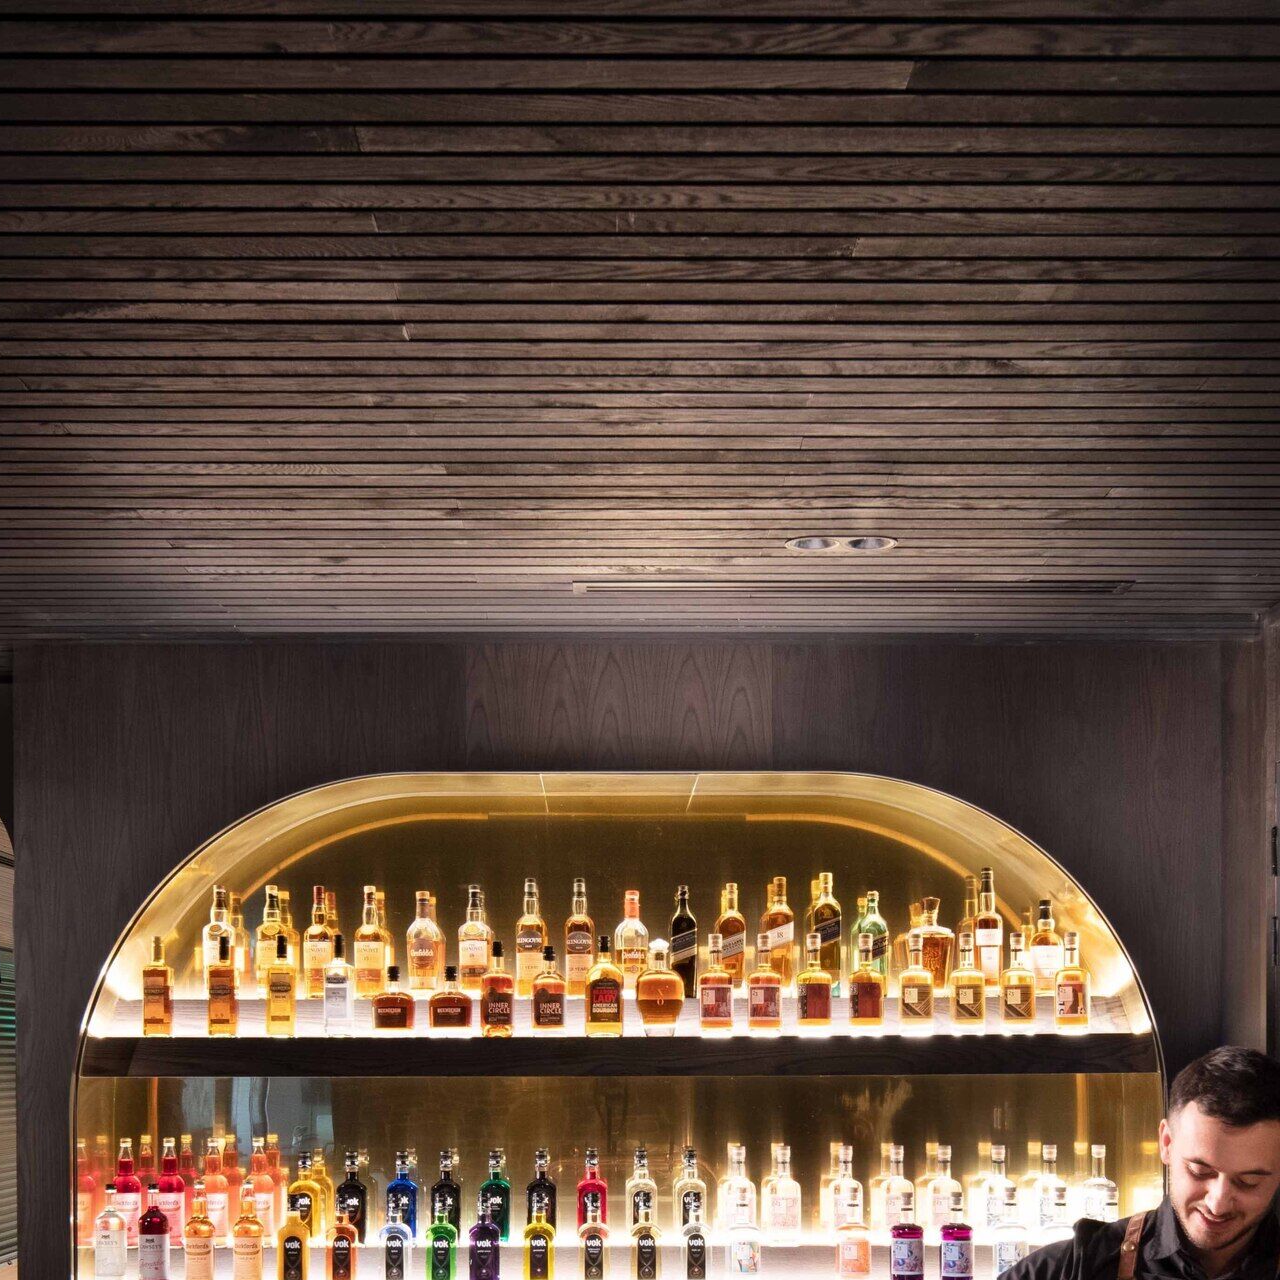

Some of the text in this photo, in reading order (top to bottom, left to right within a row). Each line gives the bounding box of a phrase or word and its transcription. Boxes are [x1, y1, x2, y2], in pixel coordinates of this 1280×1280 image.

[593, 995, 617, 1003] LADY
[285, 1240, 300, 1248] vok
[334, 1240, 349, 1248] vok
[434, 1240, 449, 1248] vok
[639, 1238, 654, 1246] vok
[688, 1238, 704, 1246] vok
